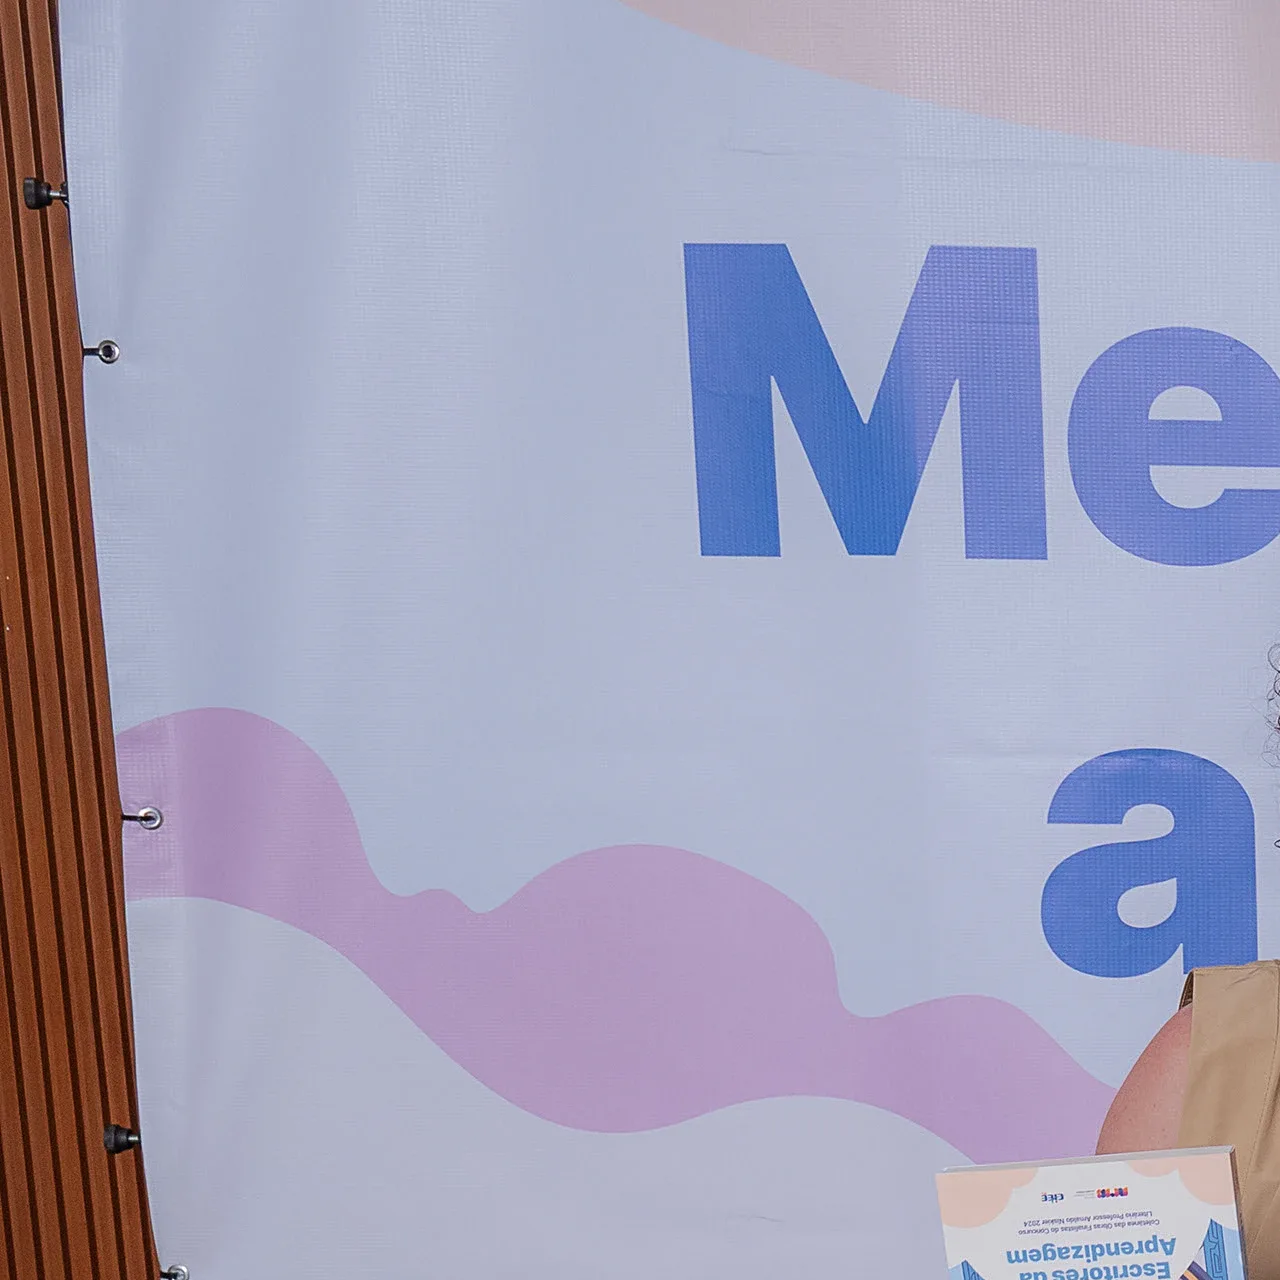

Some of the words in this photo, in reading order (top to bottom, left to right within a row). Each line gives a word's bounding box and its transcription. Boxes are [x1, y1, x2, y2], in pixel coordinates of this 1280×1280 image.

[1066, 1214, 1091, 1222] Arnaldo
[1093, 1212, 1124, 1220] Professor
[1024, 1219, 1040, 1227] 2024
[1094, 1222, 1112, 1230] Obras
[1018, 1228, 1050, 1236] Concurso
[1051, 1226, 1060, 1234] do
[1061, 1224, 1092, 1232] Finalistas
[1006, 1234, 1176, 1264] Aprendizagem
